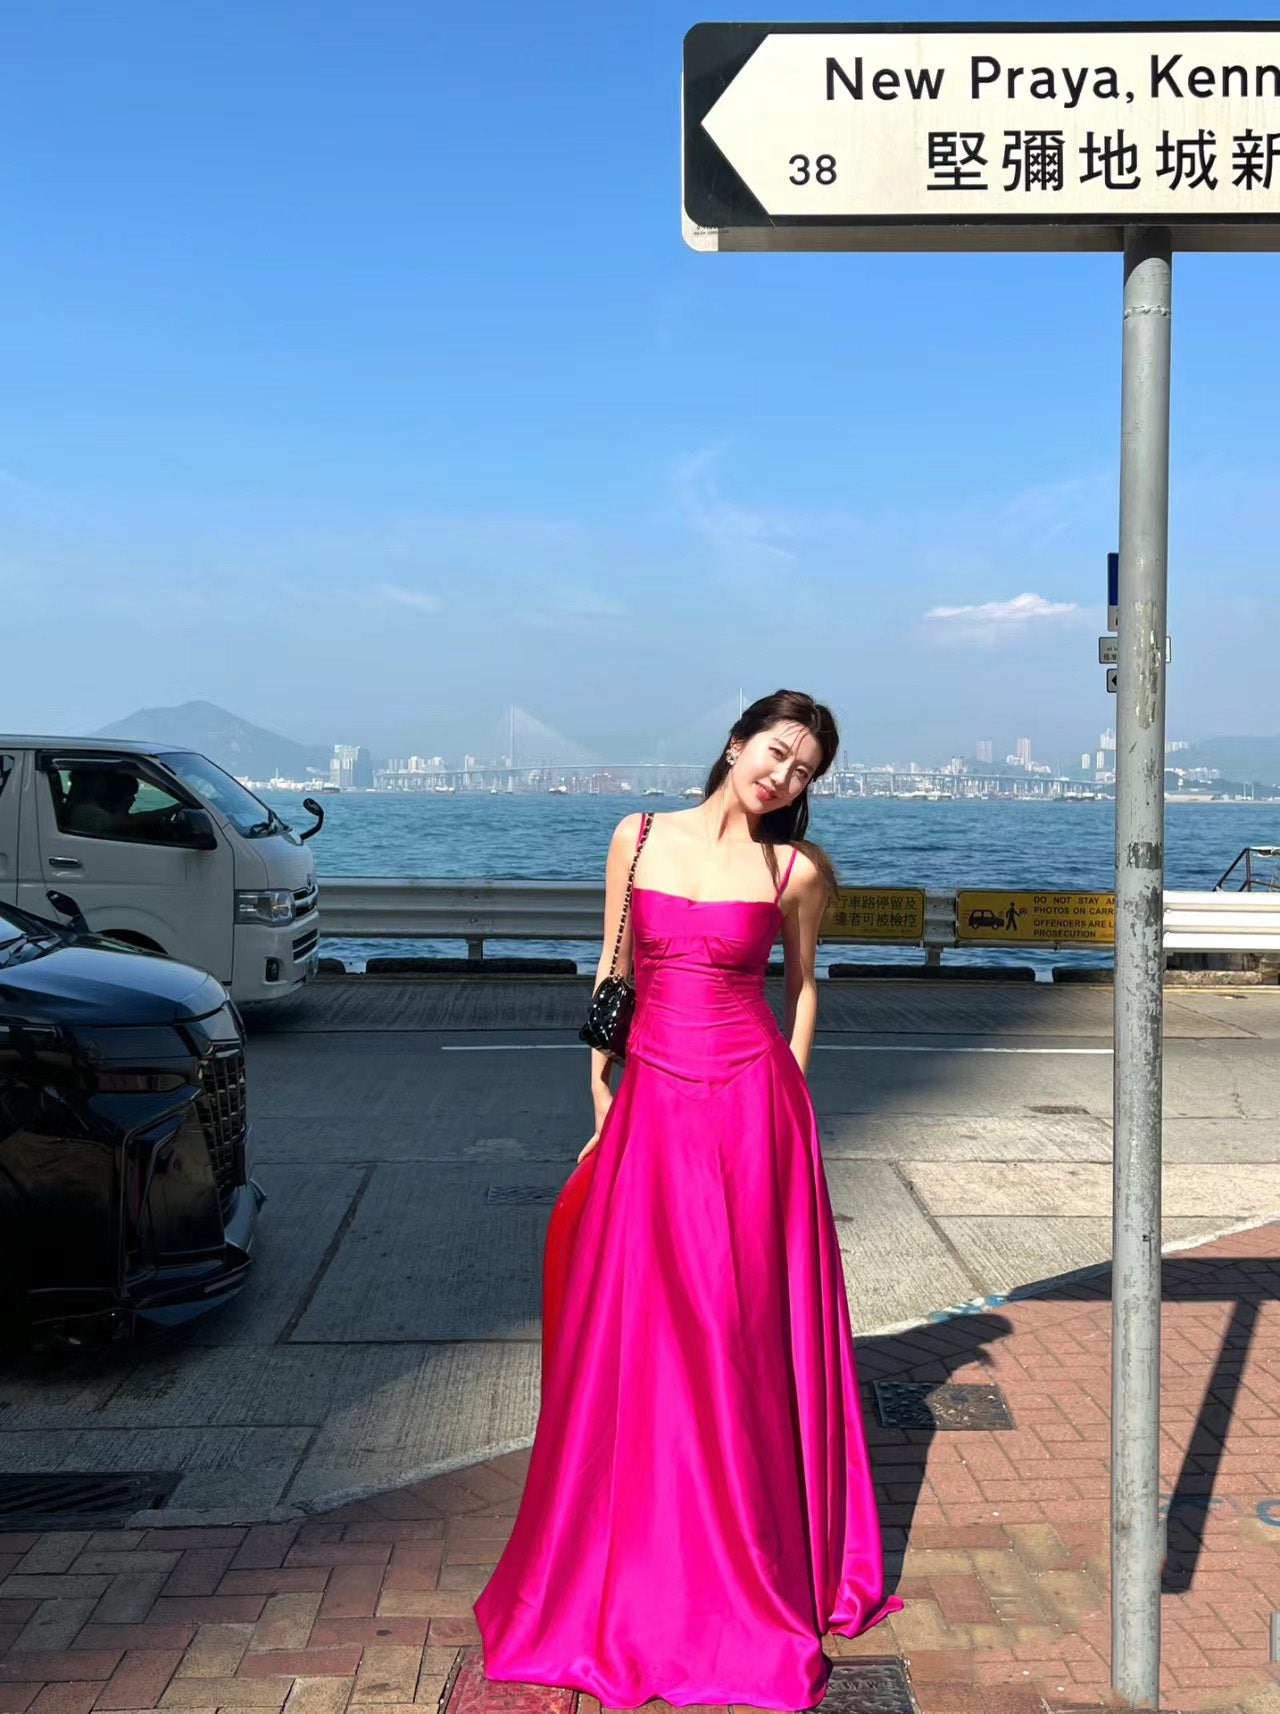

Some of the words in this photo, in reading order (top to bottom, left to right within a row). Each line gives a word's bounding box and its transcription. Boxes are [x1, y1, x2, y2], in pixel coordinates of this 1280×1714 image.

[826, 56, 945, 101] New
[971, 55, 1135, 108] Praya,
[1151, 54, 1280, 98] Kenn
[926, 128, 1280, 192] 堅彌地城新
[788, 154, 837, 186] 38
[1053, 896, 1072, 904] NOT
[1078, 897, 1099, 905] STAY
[1034, 906, 1069, 914] PHOTOS
[1073, 907, 1086, 915] ON
[1034, 919, 1086, 928] OFFENDERS
[1088, 920, 1106, 928] ARE
[1034, 929, 1096, 938] PROSECUTION
